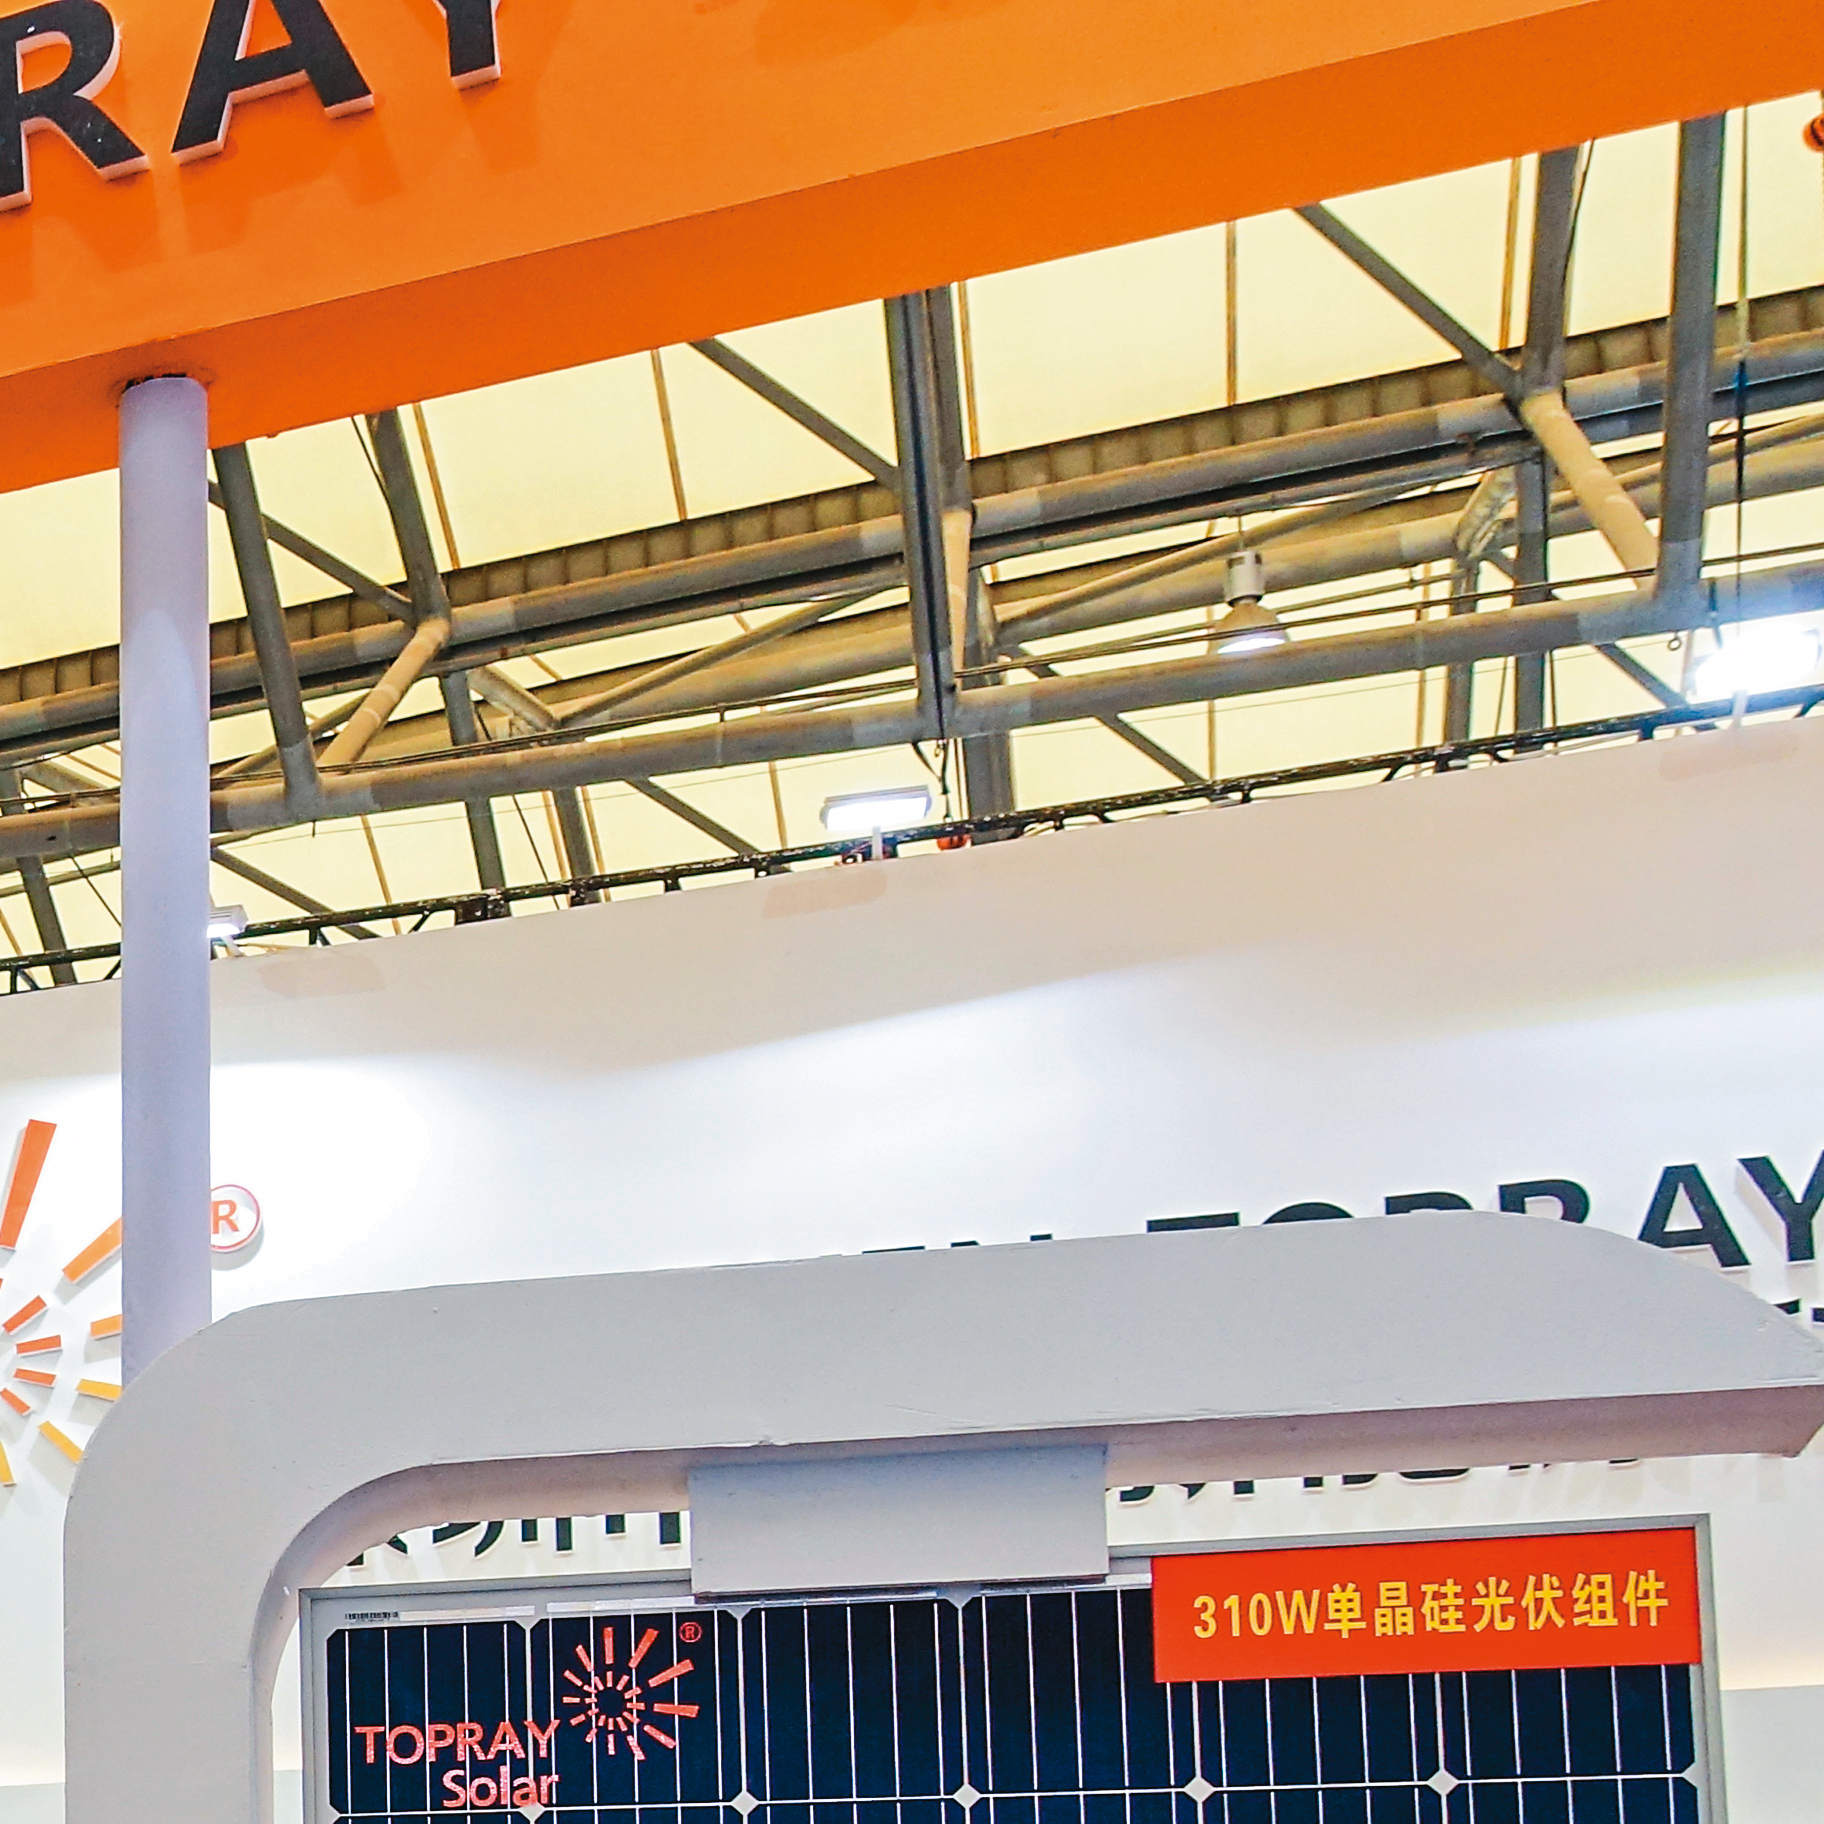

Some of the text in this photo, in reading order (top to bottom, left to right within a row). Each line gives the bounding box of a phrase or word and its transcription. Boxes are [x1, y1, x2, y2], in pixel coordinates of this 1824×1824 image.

[1192, 1570, 1669, 1641] 310W单晶硅光伏组件
[355, 1719, 559, 1766] TOPRAY
[442, 1765, 559, 1808] Solar
